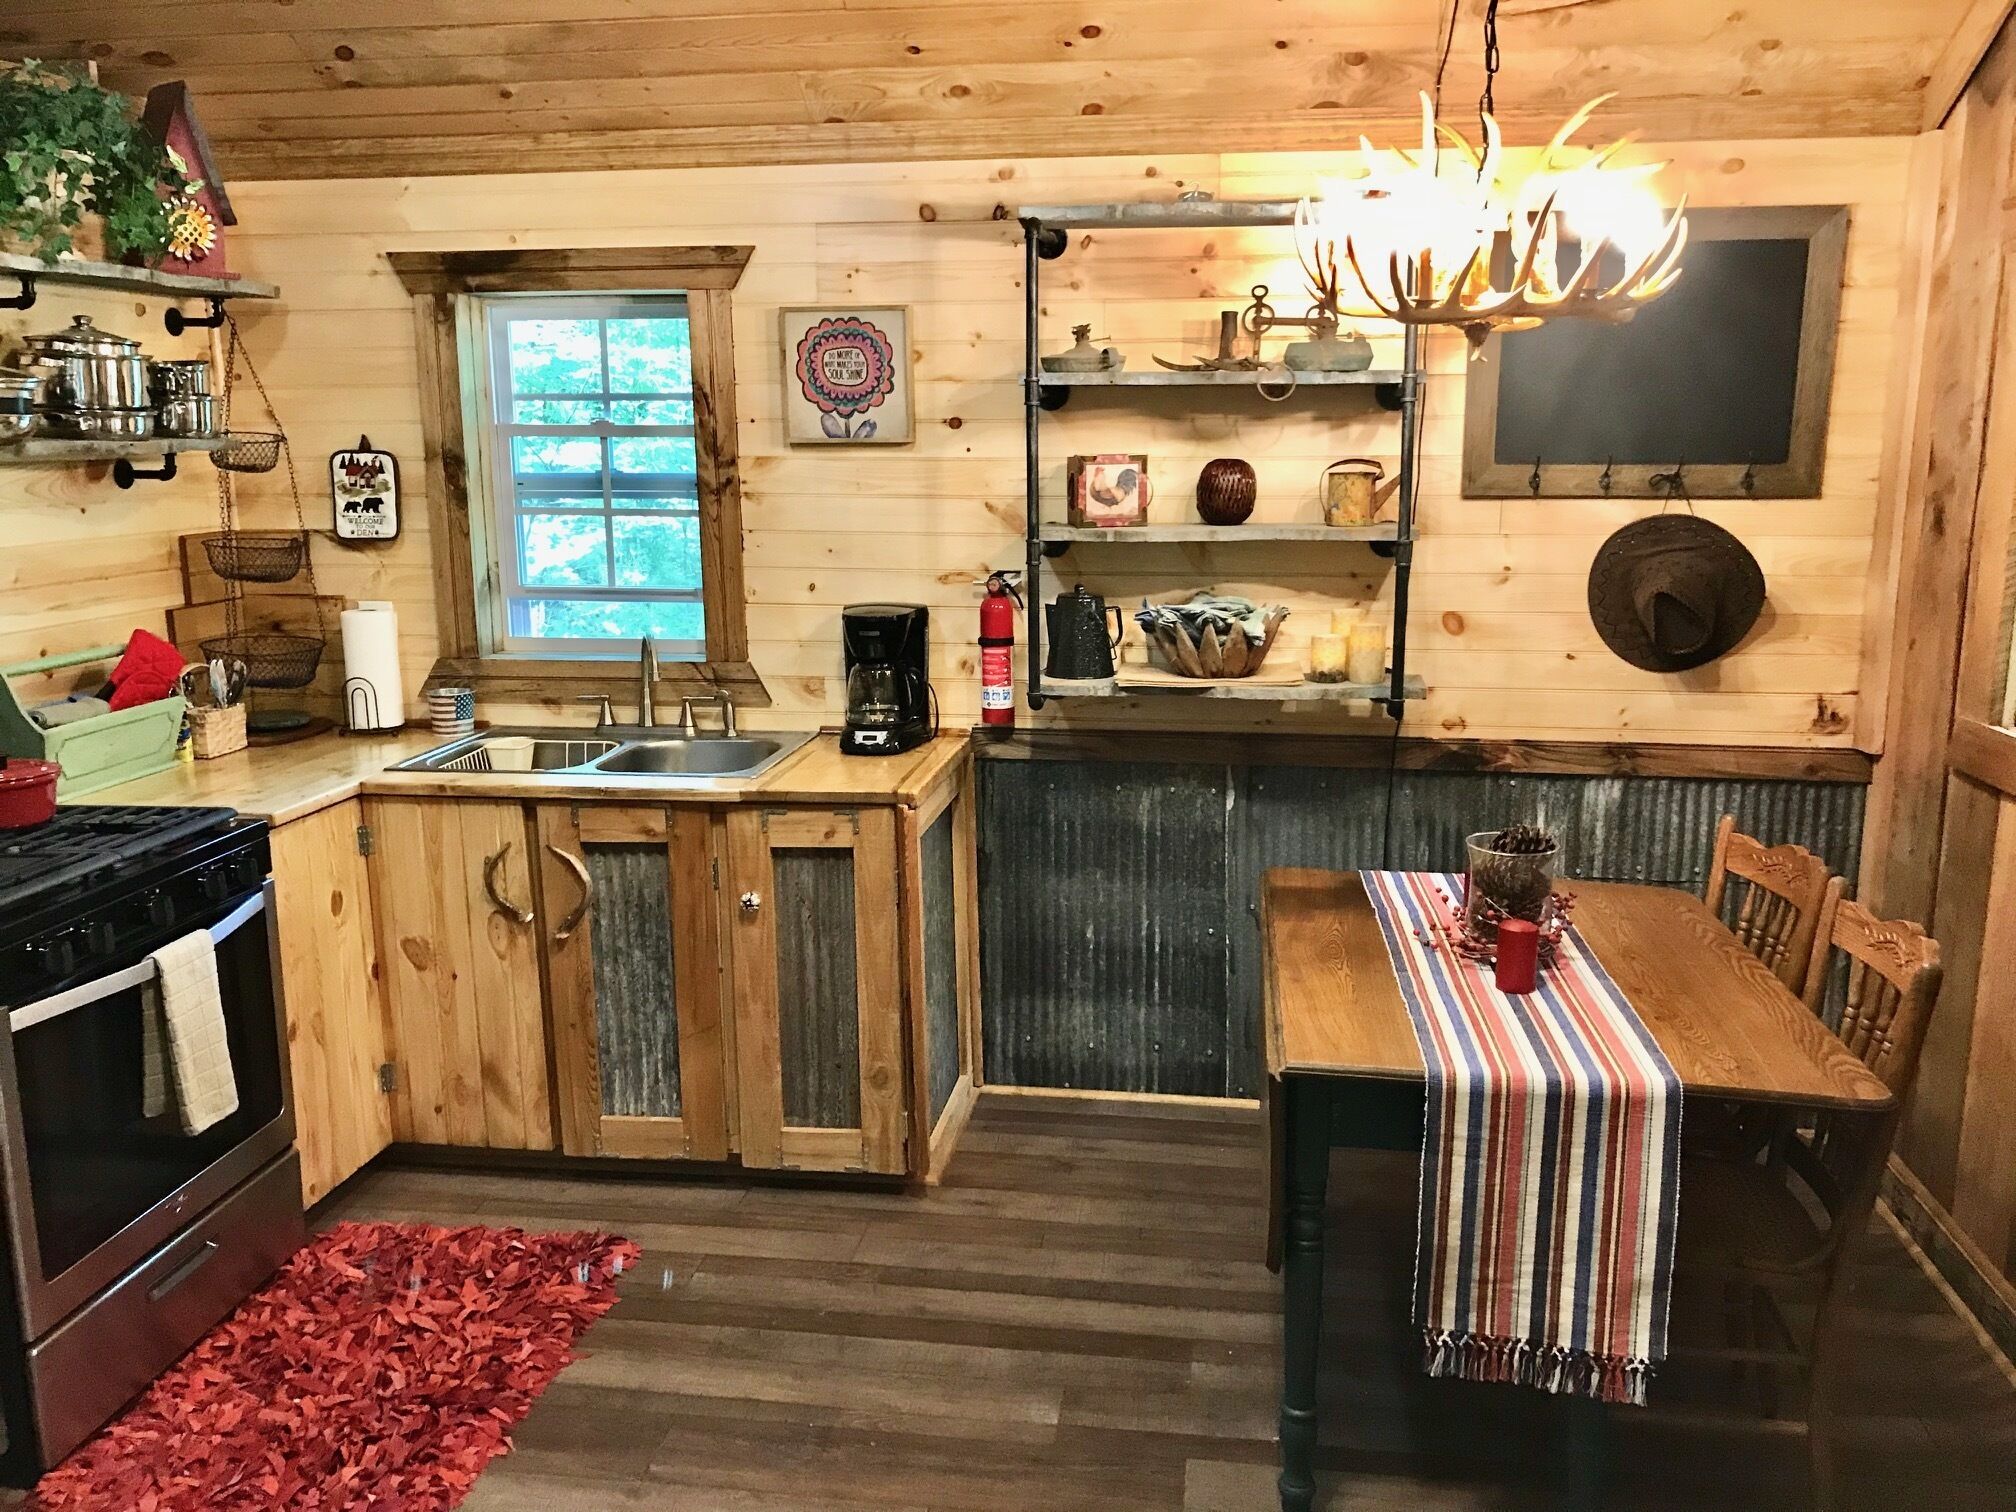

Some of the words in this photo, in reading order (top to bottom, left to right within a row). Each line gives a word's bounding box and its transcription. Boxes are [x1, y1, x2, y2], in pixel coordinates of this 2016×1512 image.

[837, 350, 853, 359] MORE
[828, 369, 844, 379] SOUL
[846, 369, 863, 380] SHINE
